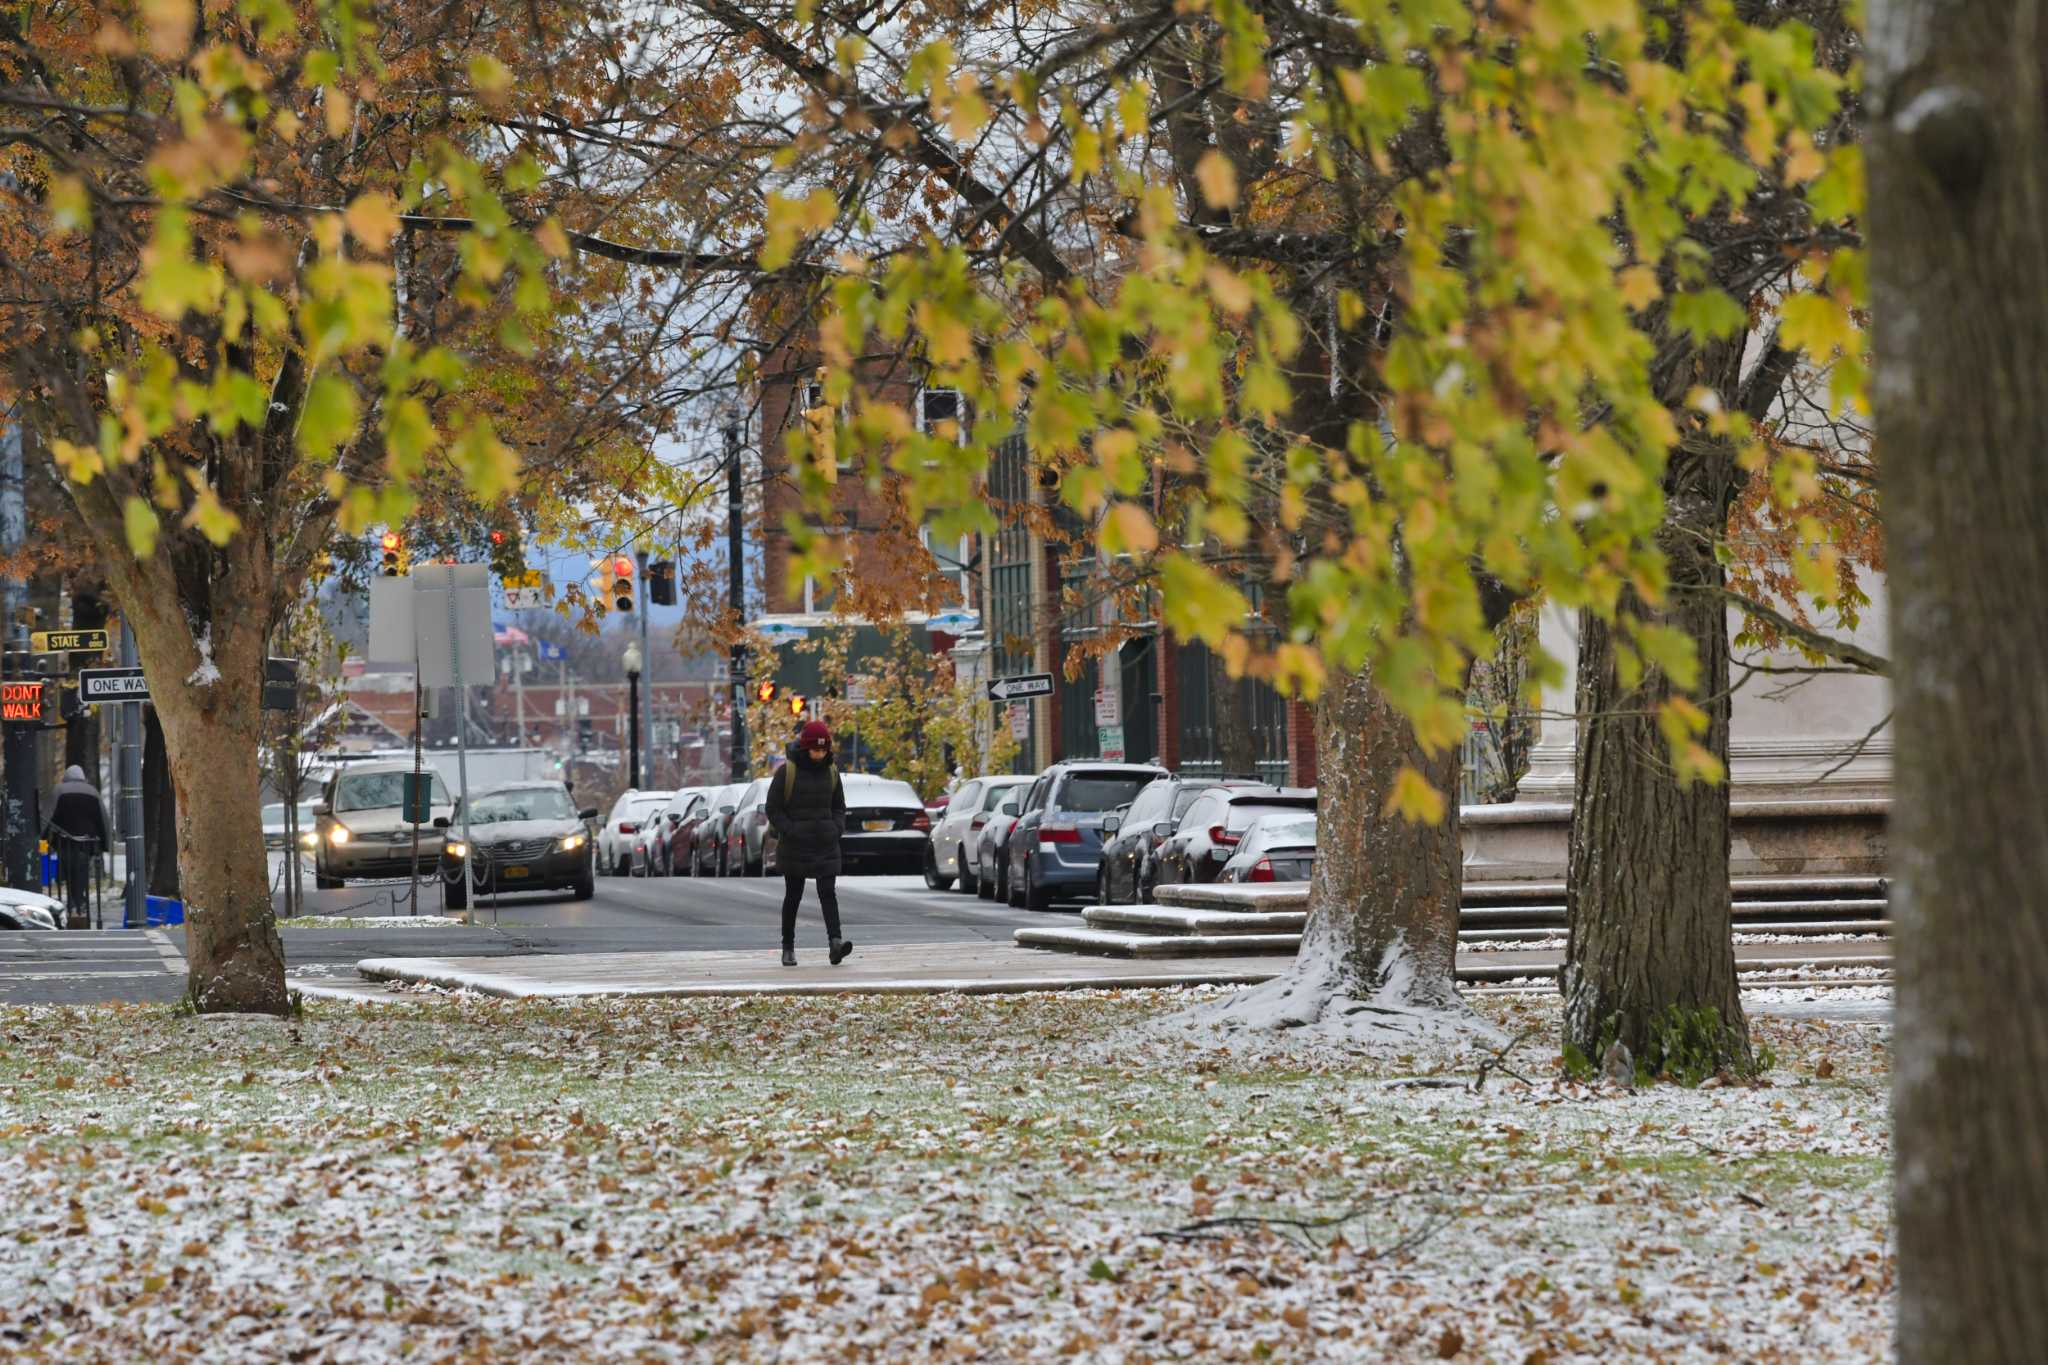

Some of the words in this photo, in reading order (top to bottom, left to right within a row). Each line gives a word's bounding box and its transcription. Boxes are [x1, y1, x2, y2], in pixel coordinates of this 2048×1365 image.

[51, 634, 80, 648] STATE
[93, 679, 120, 692] ONE
[1007, 682, 1024, 693] ONE
[1027, 681, 1046, 690] WAY
[2, 686, 42, 701] DONT
[3, 703, 41, 719] WALK
